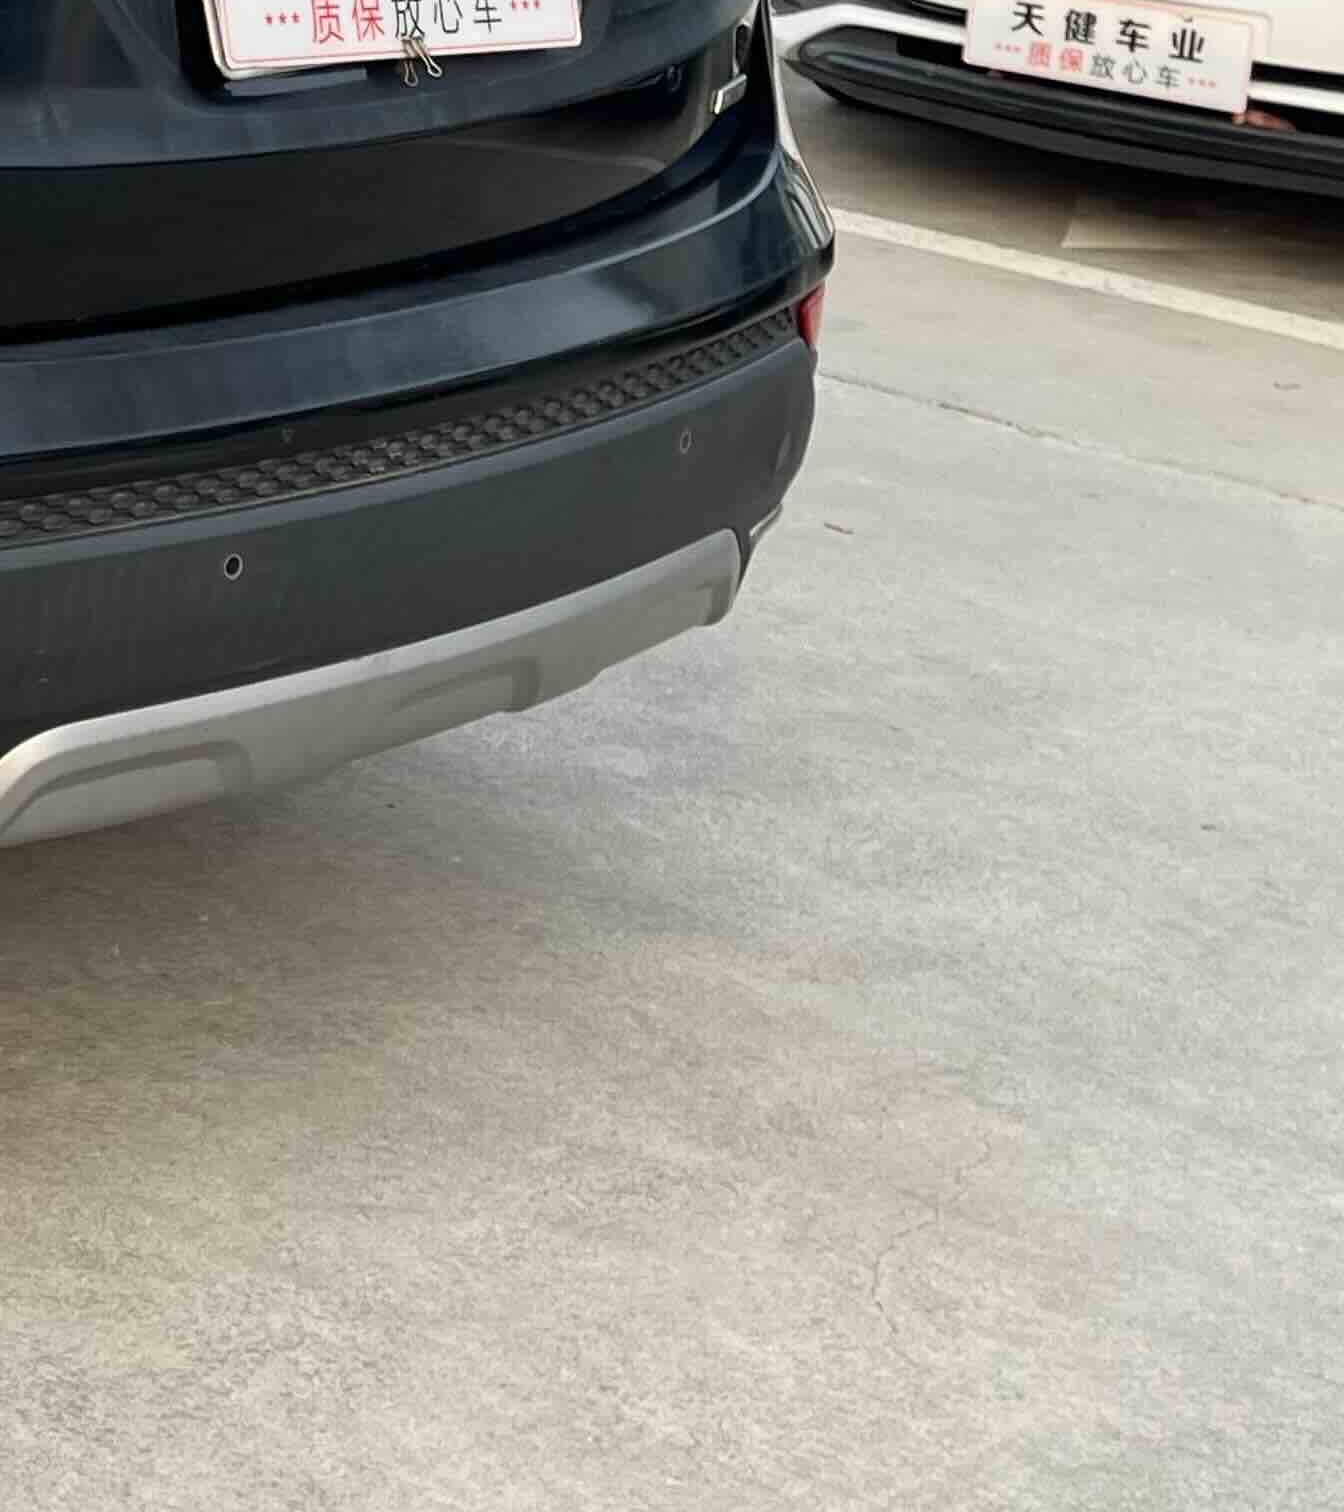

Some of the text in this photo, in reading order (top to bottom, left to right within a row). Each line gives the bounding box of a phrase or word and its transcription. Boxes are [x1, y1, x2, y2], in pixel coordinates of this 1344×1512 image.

[1011, 1, 1205, 63] 天健车业
[1028, 42, 1182, 88] 质保放心车
